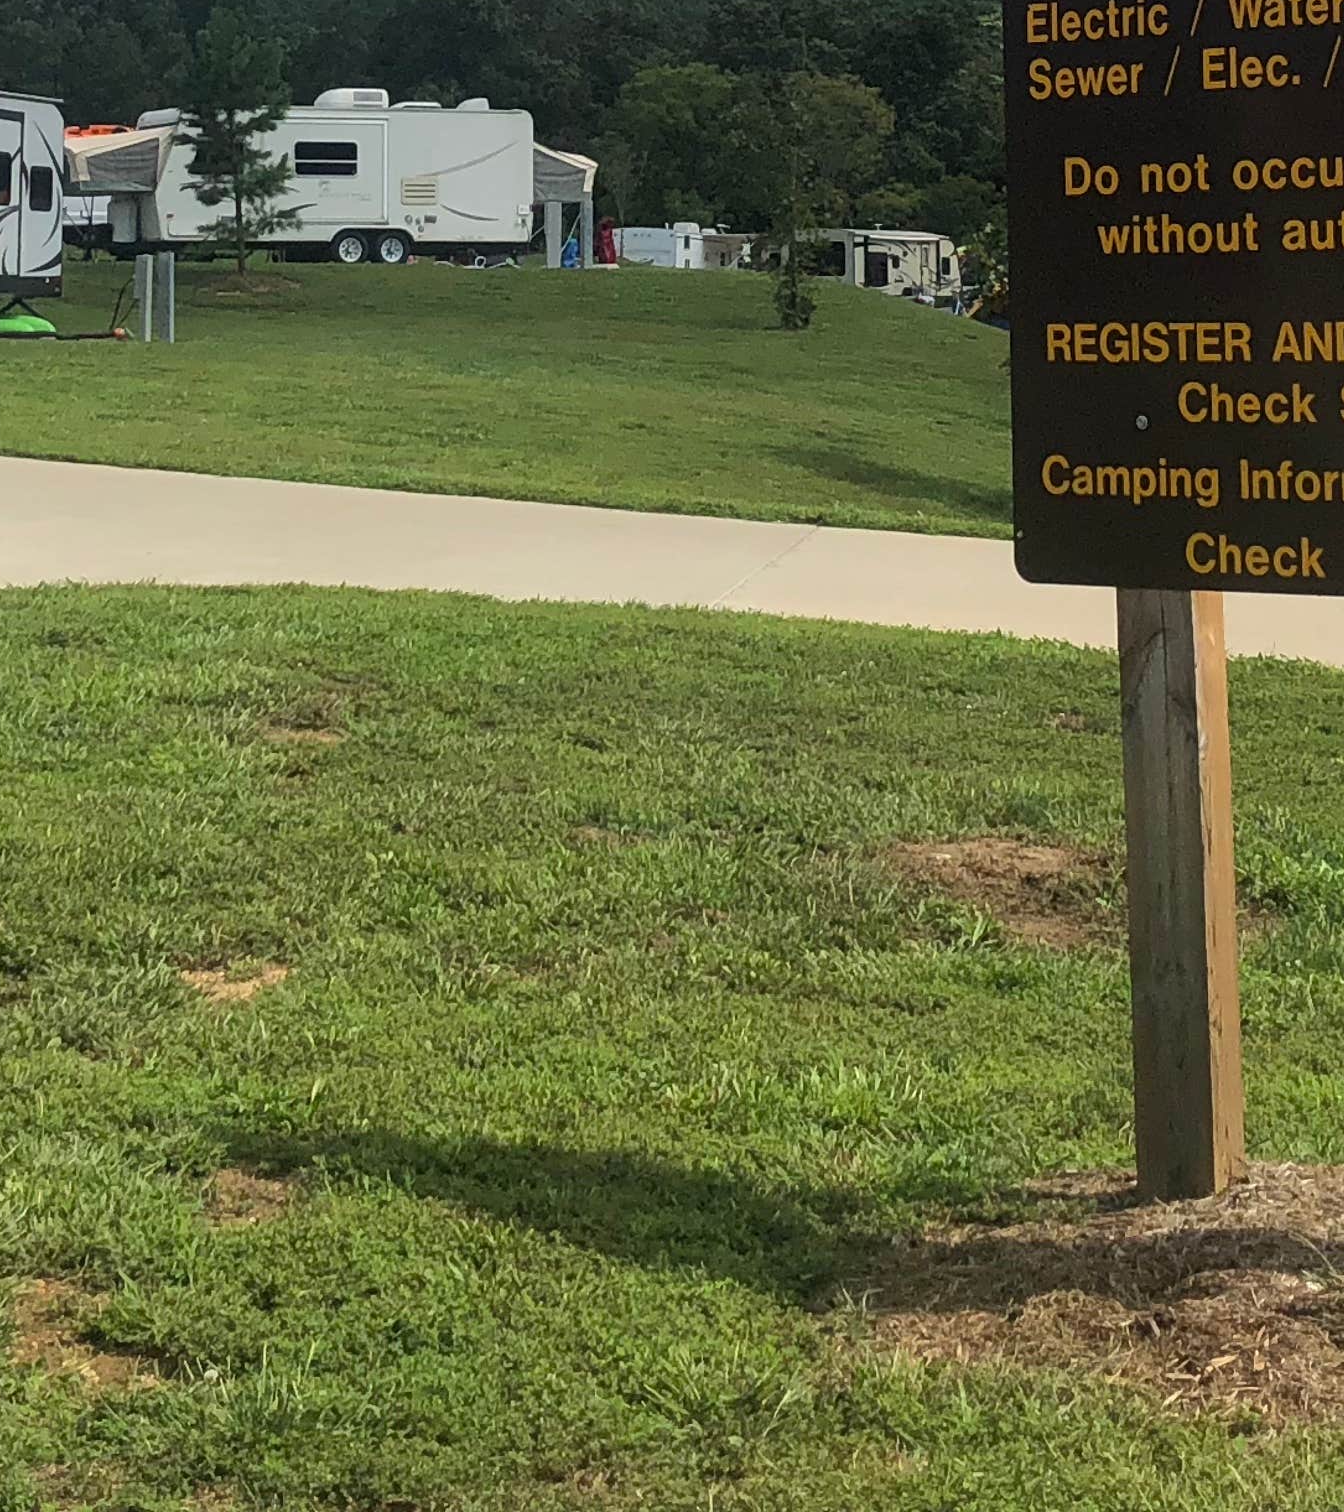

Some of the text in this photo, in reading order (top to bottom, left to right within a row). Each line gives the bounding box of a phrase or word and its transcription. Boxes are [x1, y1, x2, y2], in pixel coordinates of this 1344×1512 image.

[1029, 58, 1144, 100] Sewer
[1202, 46, 1302, 90] Elec.
[1064, 156, 1120, 196] Do
[1141, 154, 1210, 193] not
[1098, 212, 1259, 254] without
[1046, 321, 1251, 363] REGISTER
[1178, 381, 1317, 424] Check
[1042, 454, 1219, 508] Camping
[1185, 532, 1326, 578] Check
